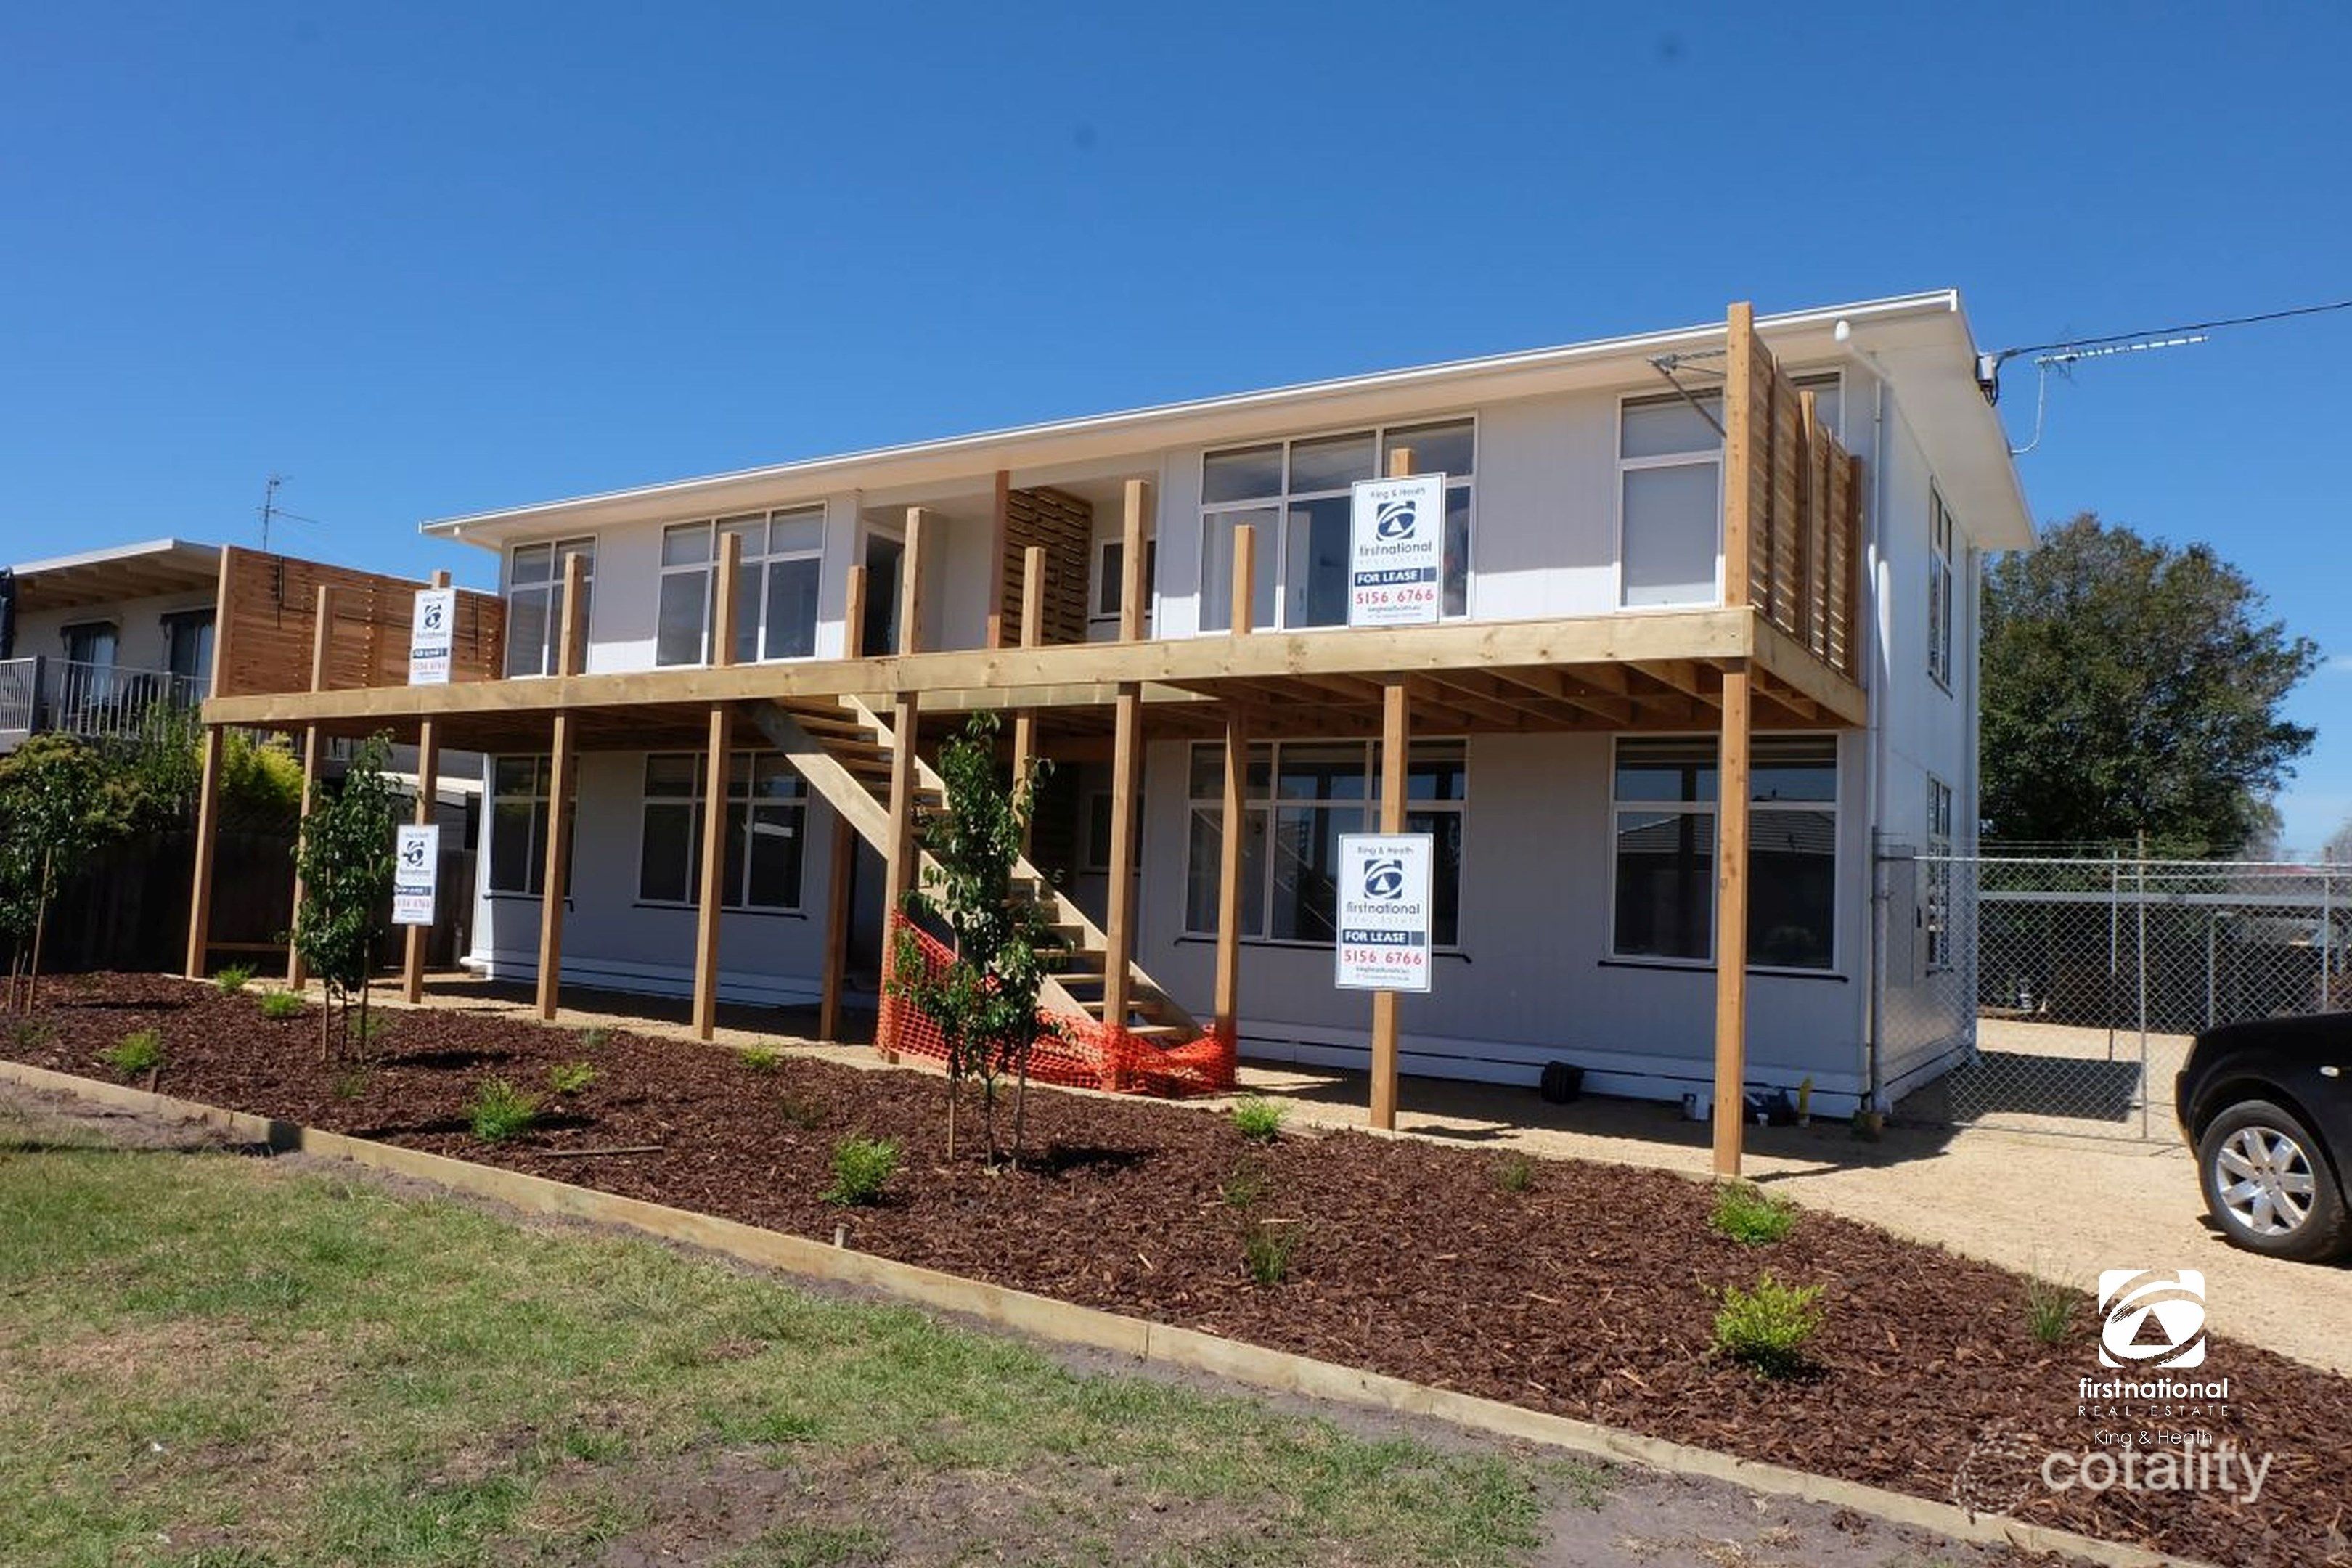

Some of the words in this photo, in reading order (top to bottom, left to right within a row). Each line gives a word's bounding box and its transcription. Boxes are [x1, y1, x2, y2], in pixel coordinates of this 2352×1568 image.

[1360, 541, 1432, 557] firstnational
[1357, 573, 1379, 584] FOR
[1383, 569, 1418, 582] LEASE
[1355, 592, 1389, 604] 5156
[1397, 589, 1434, 603] 6766
[1346, 902, 1420, 914] firstnational
[1345, 931, 1367, 942] FOR
[1371, 932, 1406, 943] LEASE
[1344, 950, 1376, 963] 5156
[1385, 952, 1422, 965] 6766
